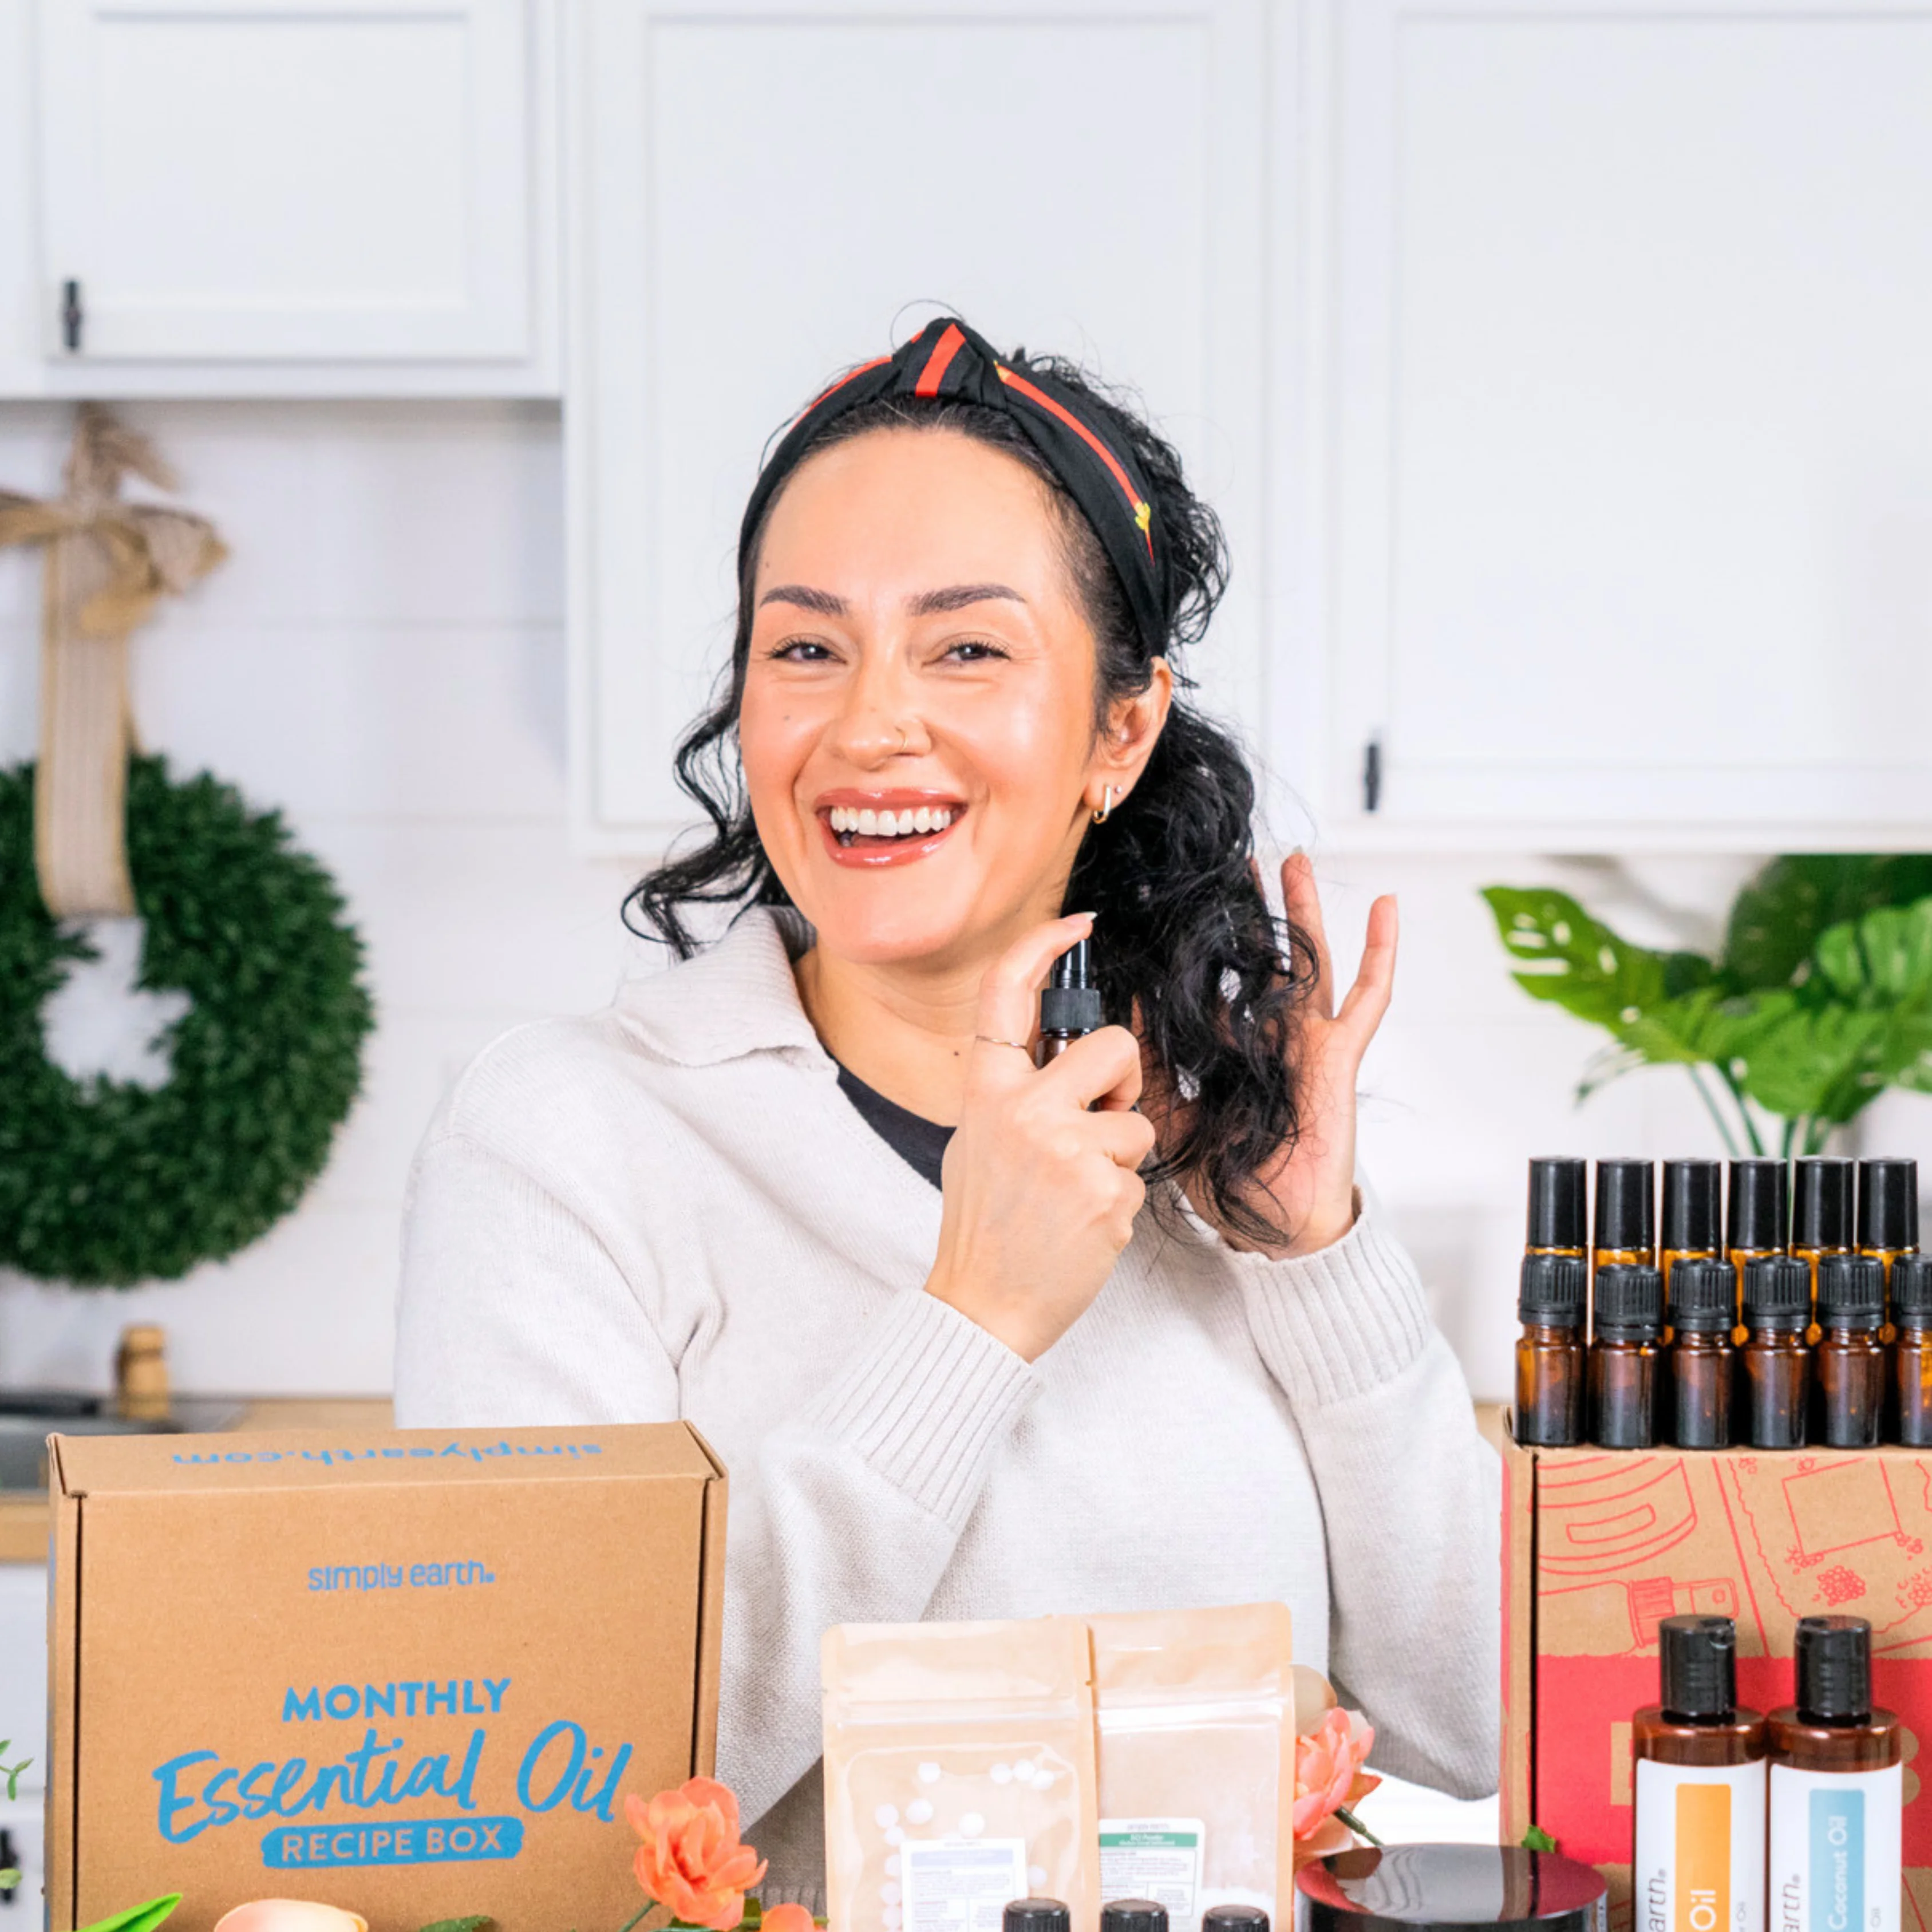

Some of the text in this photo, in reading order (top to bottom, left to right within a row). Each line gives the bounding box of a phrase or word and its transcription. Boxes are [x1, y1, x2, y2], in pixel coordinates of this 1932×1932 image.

[172, 1441, 602, 1465] simplyearth.com
[308, 1562, 403, 1591] simply
[282, 1678, 512, 1722] MONTHLY
[151, 1720, 634, 1844] Essential Oil
[282, 1824, 502, 1862] RECIPE BOX
[1828, 1816, 1848, 1931] Coconut Oil
[1690, 1890, 1716, 1931] Oil
